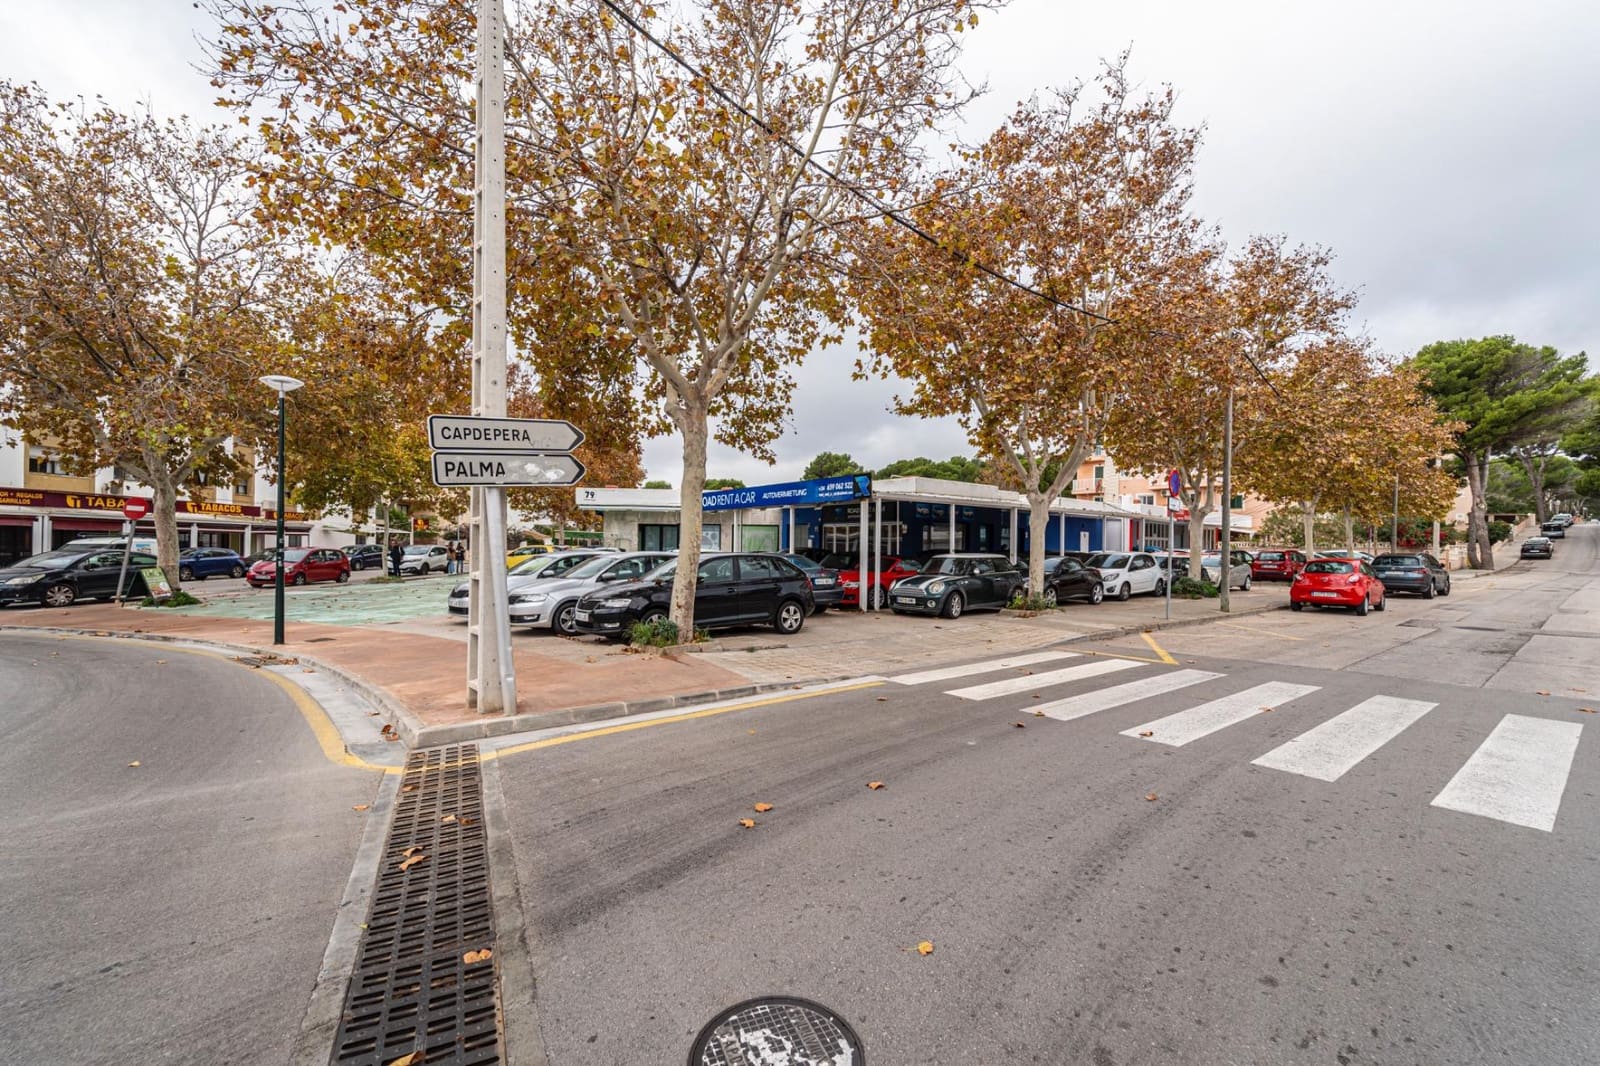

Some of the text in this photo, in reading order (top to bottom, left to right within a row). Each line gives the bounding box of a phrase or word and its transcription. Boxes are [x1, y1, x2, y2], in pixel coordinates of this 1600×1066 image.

[441, 426, 531, 442] CAPDEPERA
[444, 461, 506, 477] PALMA
[584, 490, 596, 499] 79
[702, 491, 756, 507] OAD RENT A CAR
[85, 496, 126, 508] TABA
[201, 502, 242, 513] TABACOS
